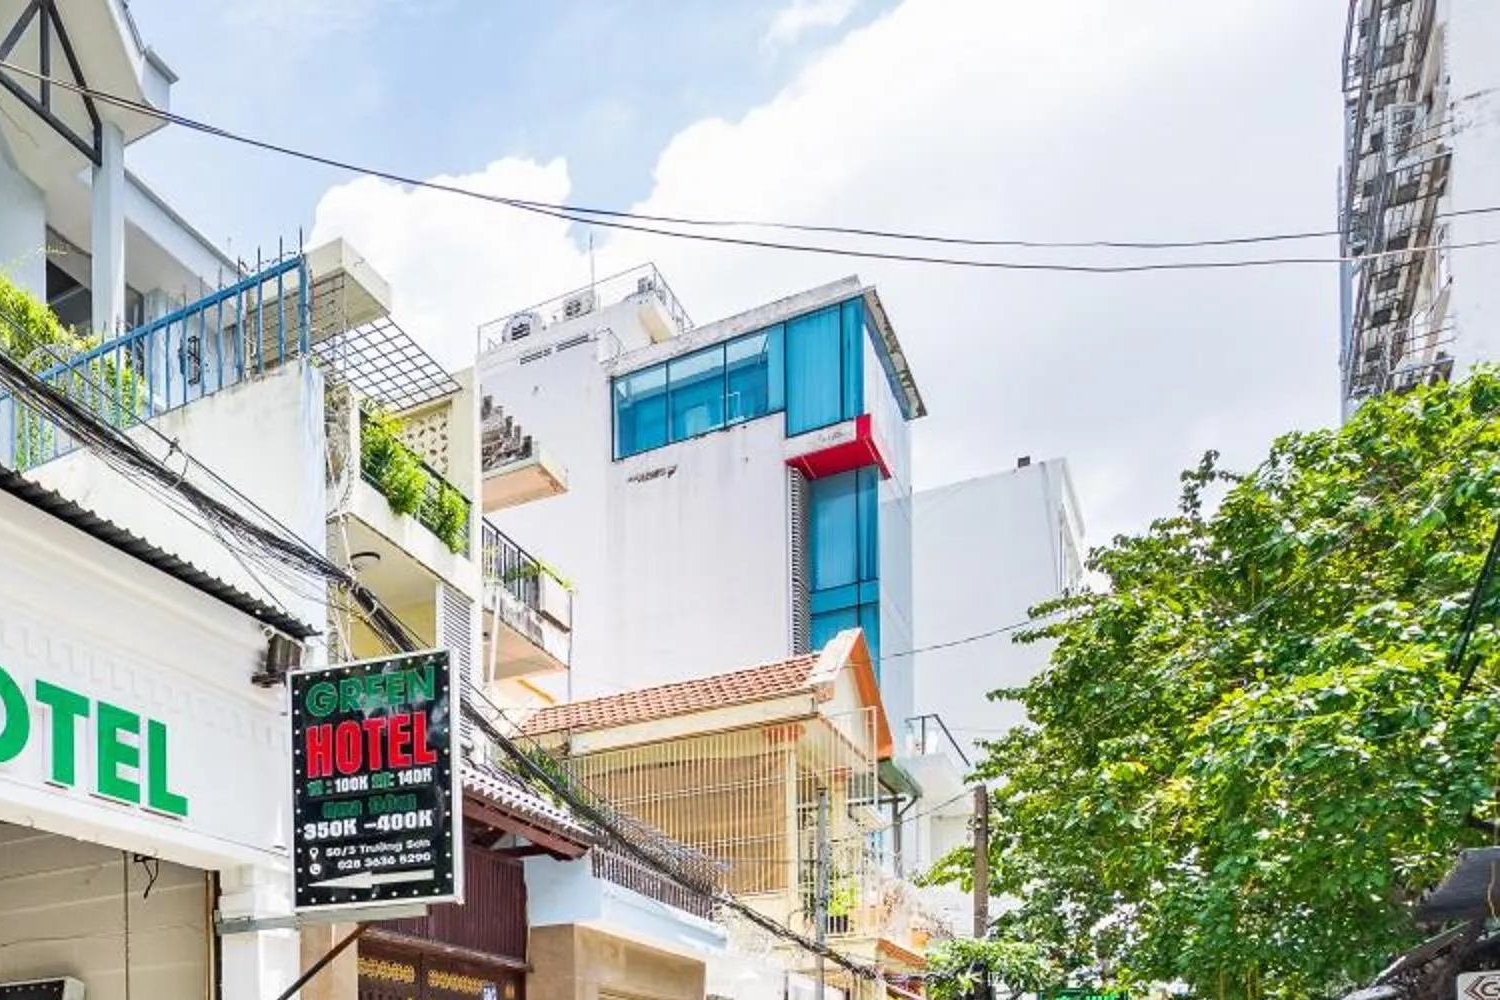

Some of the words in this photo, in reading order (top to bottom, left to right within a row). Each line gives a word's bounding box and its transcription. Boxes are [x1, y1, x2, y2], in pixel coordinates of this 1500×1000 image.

[306, 664, 435, 717] GREEN
[306, 711, 437, 778] HOTEL
[335, 775, 368, 793] 100K
[398, 767, 432, 786] 140K
[303, 818, 357, 840] 350K
